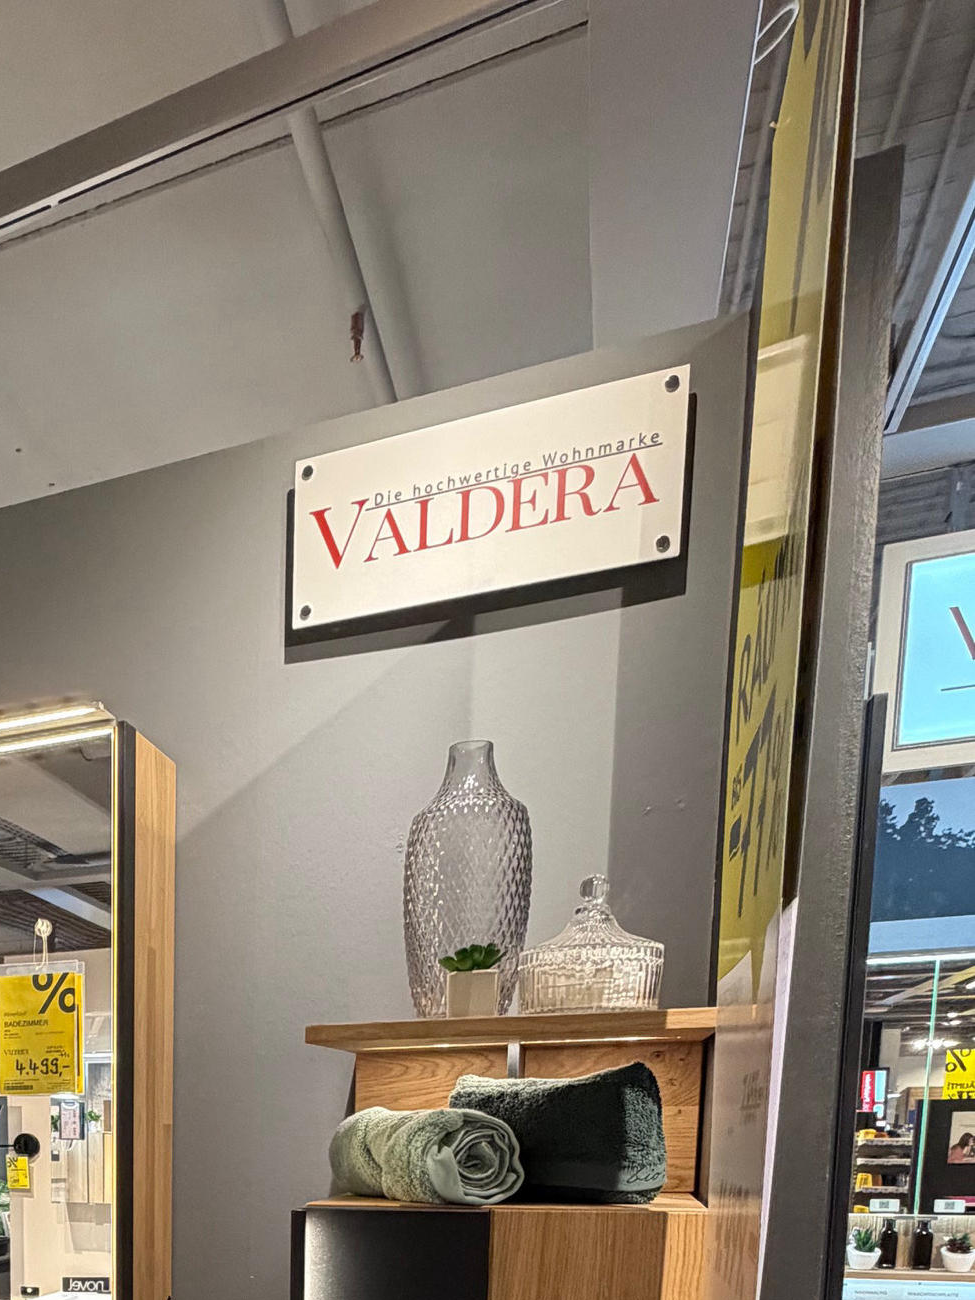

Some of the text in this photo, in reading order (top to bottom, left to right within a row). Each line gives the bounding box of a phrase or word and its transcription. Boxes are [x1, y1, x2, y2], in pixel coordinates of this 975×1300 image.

[373, 430, 663, 507] Die hochwertige Wohnmarke
[309, 452, 660, 570] VALDERA
[3, 1019, 49, 1029] BADEZIMMER
